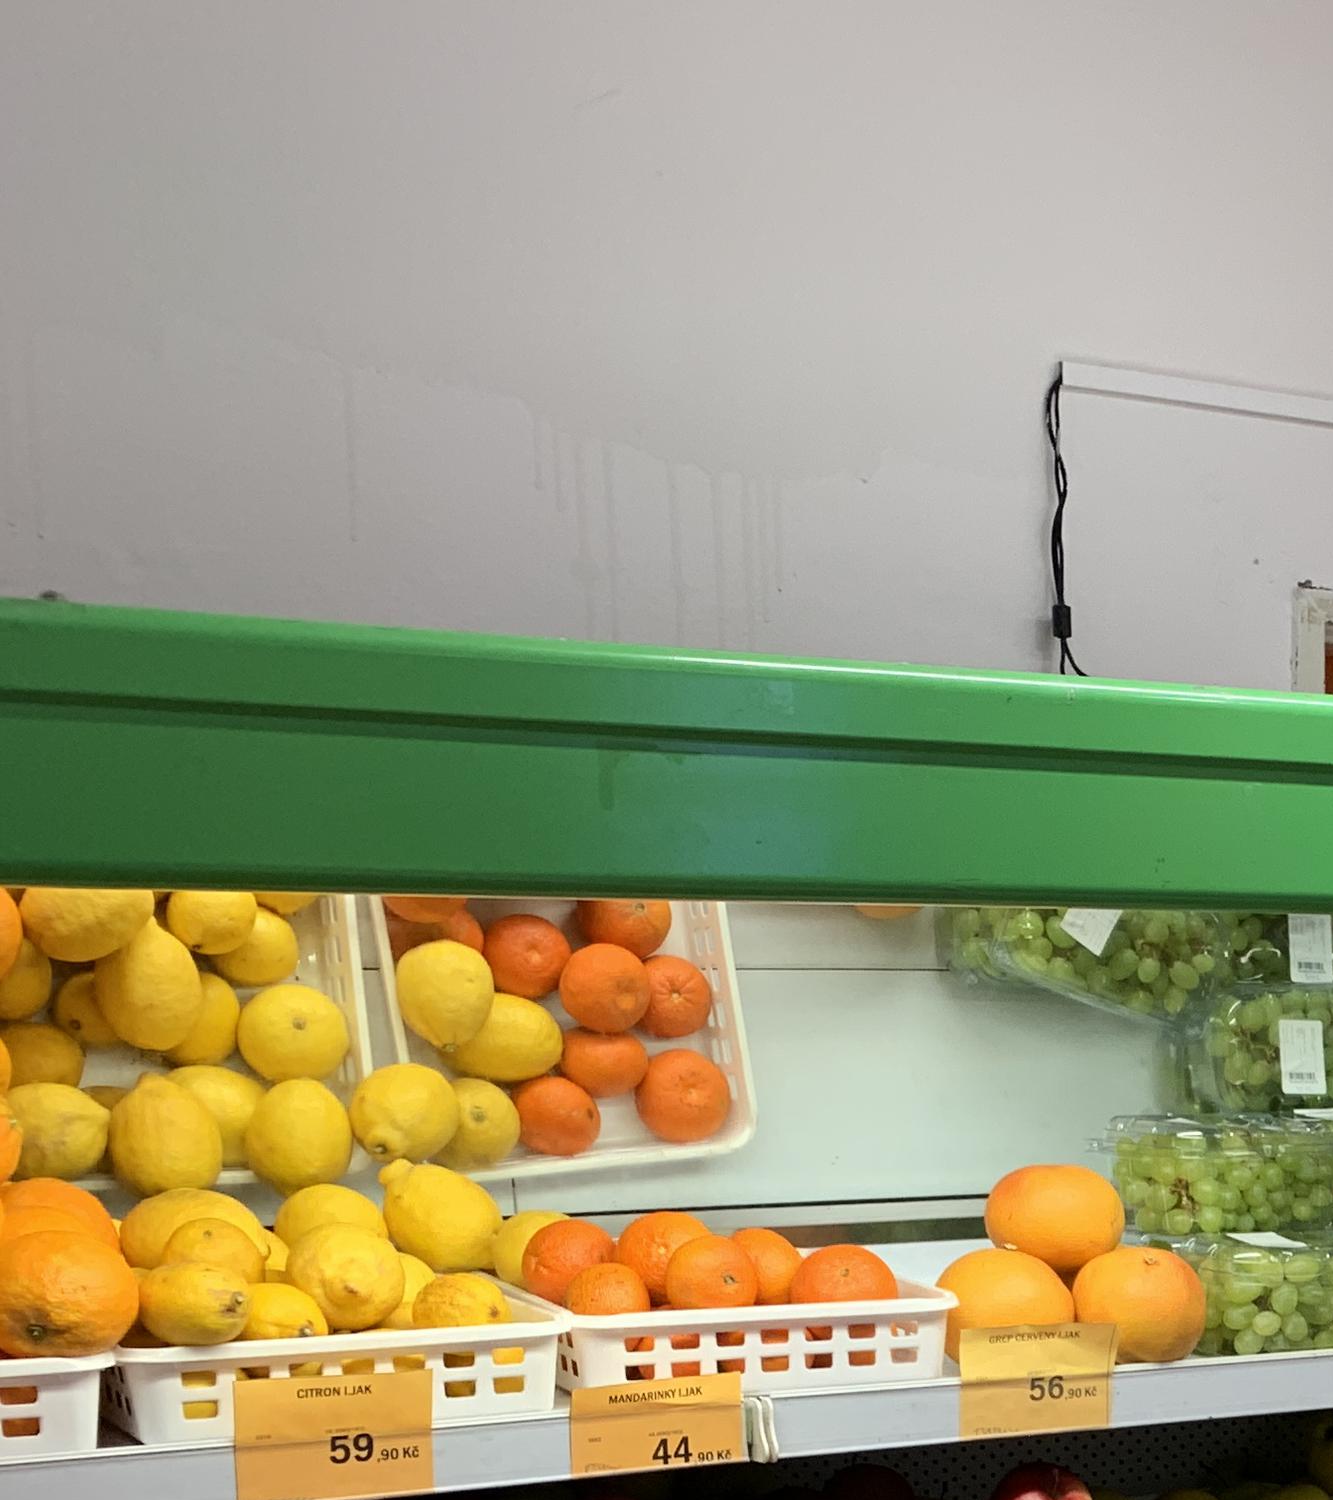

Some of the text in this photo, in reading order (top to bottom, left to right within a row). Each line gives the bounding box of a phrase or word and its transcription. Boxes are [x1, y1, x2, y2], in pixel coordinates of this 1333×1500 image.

[296, 1387, 340, 1399] CITRON
[609, 1389, 676, 1404] MANDARINKY
[1085, 1386, 1098, 1397] Kč
[403, 1446, 420, 1459] Kč
[717, 1449, 732, 1460] Kč
